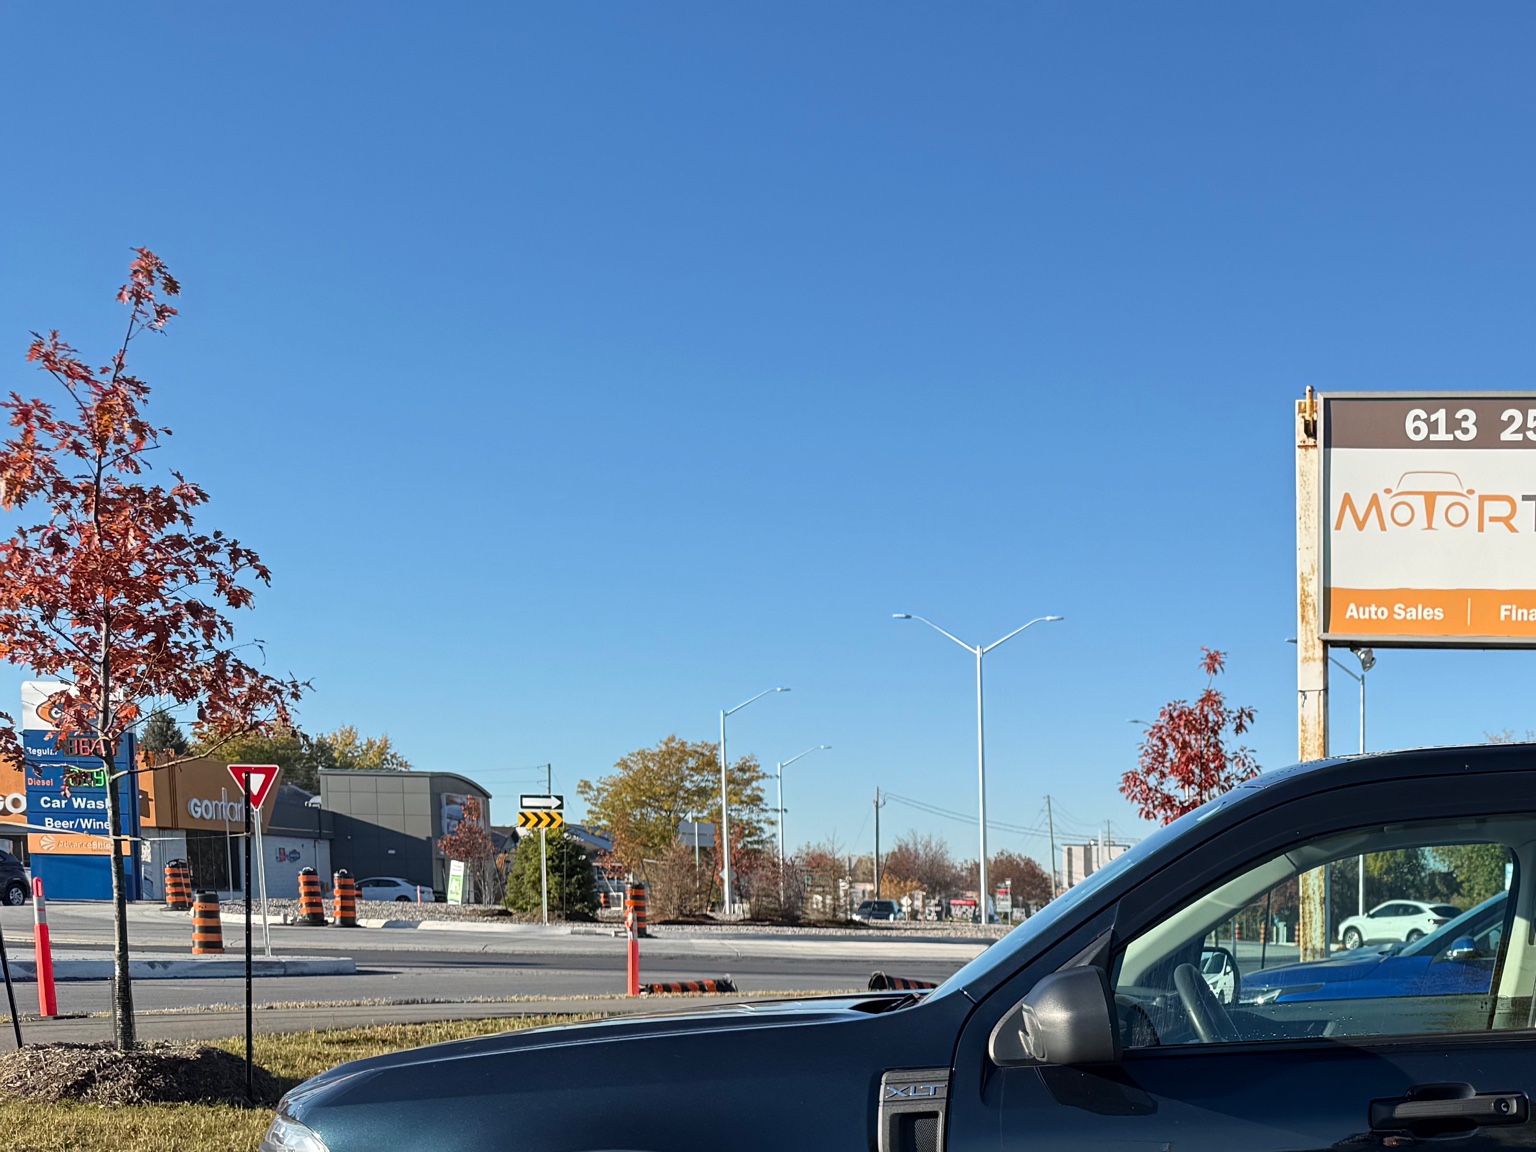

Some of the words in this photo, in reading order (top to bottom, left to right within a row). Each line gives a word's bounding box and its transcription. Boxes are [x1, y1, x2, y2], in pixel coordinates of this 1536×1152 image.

[1405, 408, 1477, 441] 613
[1345, 602, 1388, 621] Auto
[1392, 603, 1444, 621] Sales
[27, 777, 54, 787] Diesel
[0, 792, 27, 814] O
[40, 796, 68, 809] Car
[44, 817, 112, 830] Beer/Wine
[885, 1084, 947, 1099] XLT
